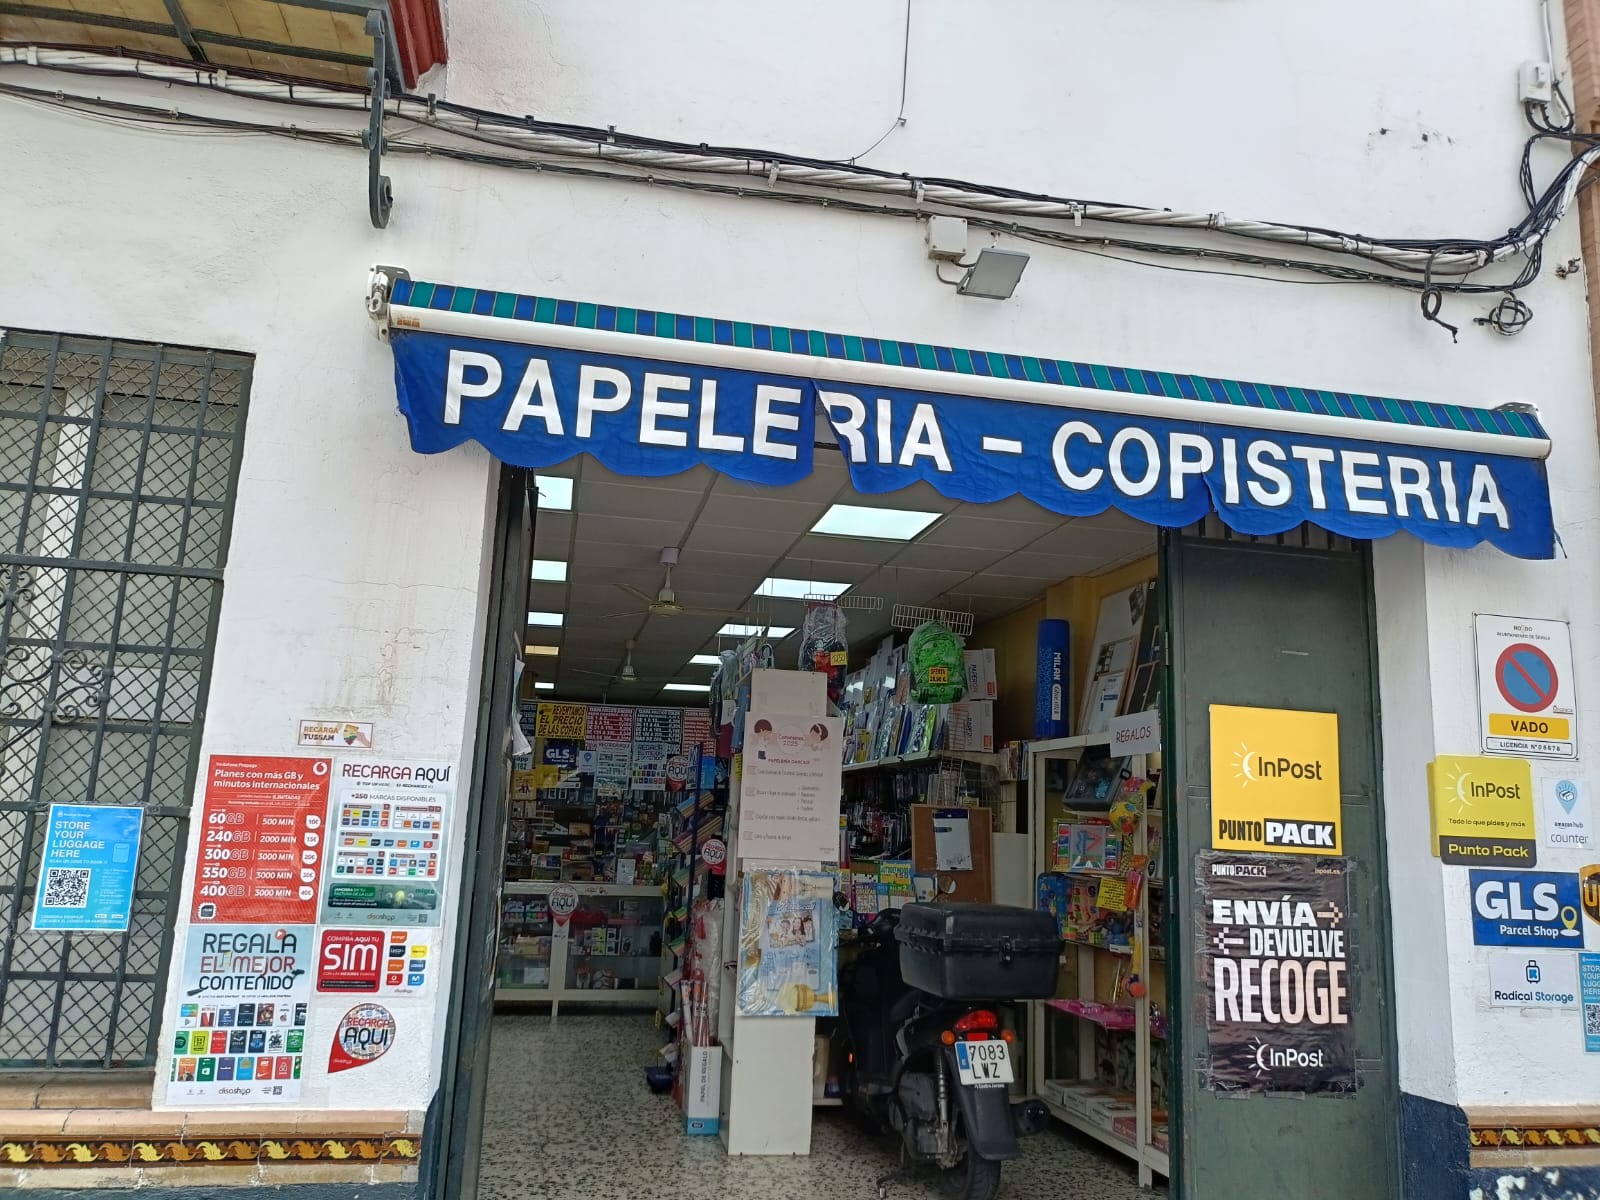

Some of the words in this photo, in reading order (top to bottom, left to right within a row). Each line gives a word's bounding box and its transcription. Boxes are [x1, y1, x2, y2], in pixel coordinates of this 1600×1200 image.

[443, 349, 953, 471] PAPELERIA
[1051, 421, 1511, 529] COPISTERIA
[1053, 652, 1062, 680] MILAN
[540, 715, 550, 724] EL
[552, 716, 583, 726] PRECIO
[1511, 720, 1548, 734] VADO
[304, 726, 338, 734] RECARGA
[538, 725, 546, 734] DE
[547, 726, 559, 734] LAS
[560, 726, 582, 736] COPIAS
[1116, 726, 1152, 743] REGALOS
[546, 748, 570, 758] GLS
[1500, 742, 1528, 750] LICENCIA
[214, 769, 244, 778] Planes
[266, 770, 283, 780] más
[284, 772, 296, 780] GB
[342, 764, 412, 780] RECARGA
[414, 766, 451, 783] AQUÍ
[1258, 756, 1322, 780] InPost
[214, 780, 251, 788] minutos
[252, 780, 320, 790] internacionales
[1470, 782, 1521, 800] InPost
[55, 821, 91, 830] STORE
[262, 818, 277, 826] 500
[278, 818, 294, 826] MIN
[54, 830, 84, 839] YOUR
[1218, 818, 1262, 842] PUNTO
[1266, 822, 1334, 846] PACK
[1550, 834, 1589, 844] counter
[52, 840, 104, 849] LUGGAGE
[260, 836, 280, 844] 2000
[280, 836, 297, 844] MIN
[50, 850, 80, 858] HERE
[1448, 844, 1490, 856] Punto
[1493, 846, 1528, 858] Pack
[276, 872, 292, 880] MIN
[1212, 864, 1234, 876] PUNTO
[1236, 865, 1265, 876] PACK
[275, 889, 292, 897] MIN
[1475, 880, 1559, 921] GLS
[1212, 895, 1318, 927] ENVÍA
[1500, 924, 1531, 936] Parcel
[1534, 926, 1558, 939] Shop
[202, 933, 298, 954] REGALA
[1250, 927, 1346, 958] DEVUELVE
[323, 944, 378, 971] SIM
[200, 956, 225, 973] EL
[232, 956, 296, 976] MEJOR
[198, 975, 294, 990] CONTENIDO
[1213, 957, 1348, 1025] RECOGE
[1494, 990, 1533, 1001] Radical
[1535, 992, 1574, 1004] Storage
[968, 1044, 1005, 1062] 7083
[1270, 1048, 1324, 1068] InPost
[972, 1062, 1000, 1079] LWZ
